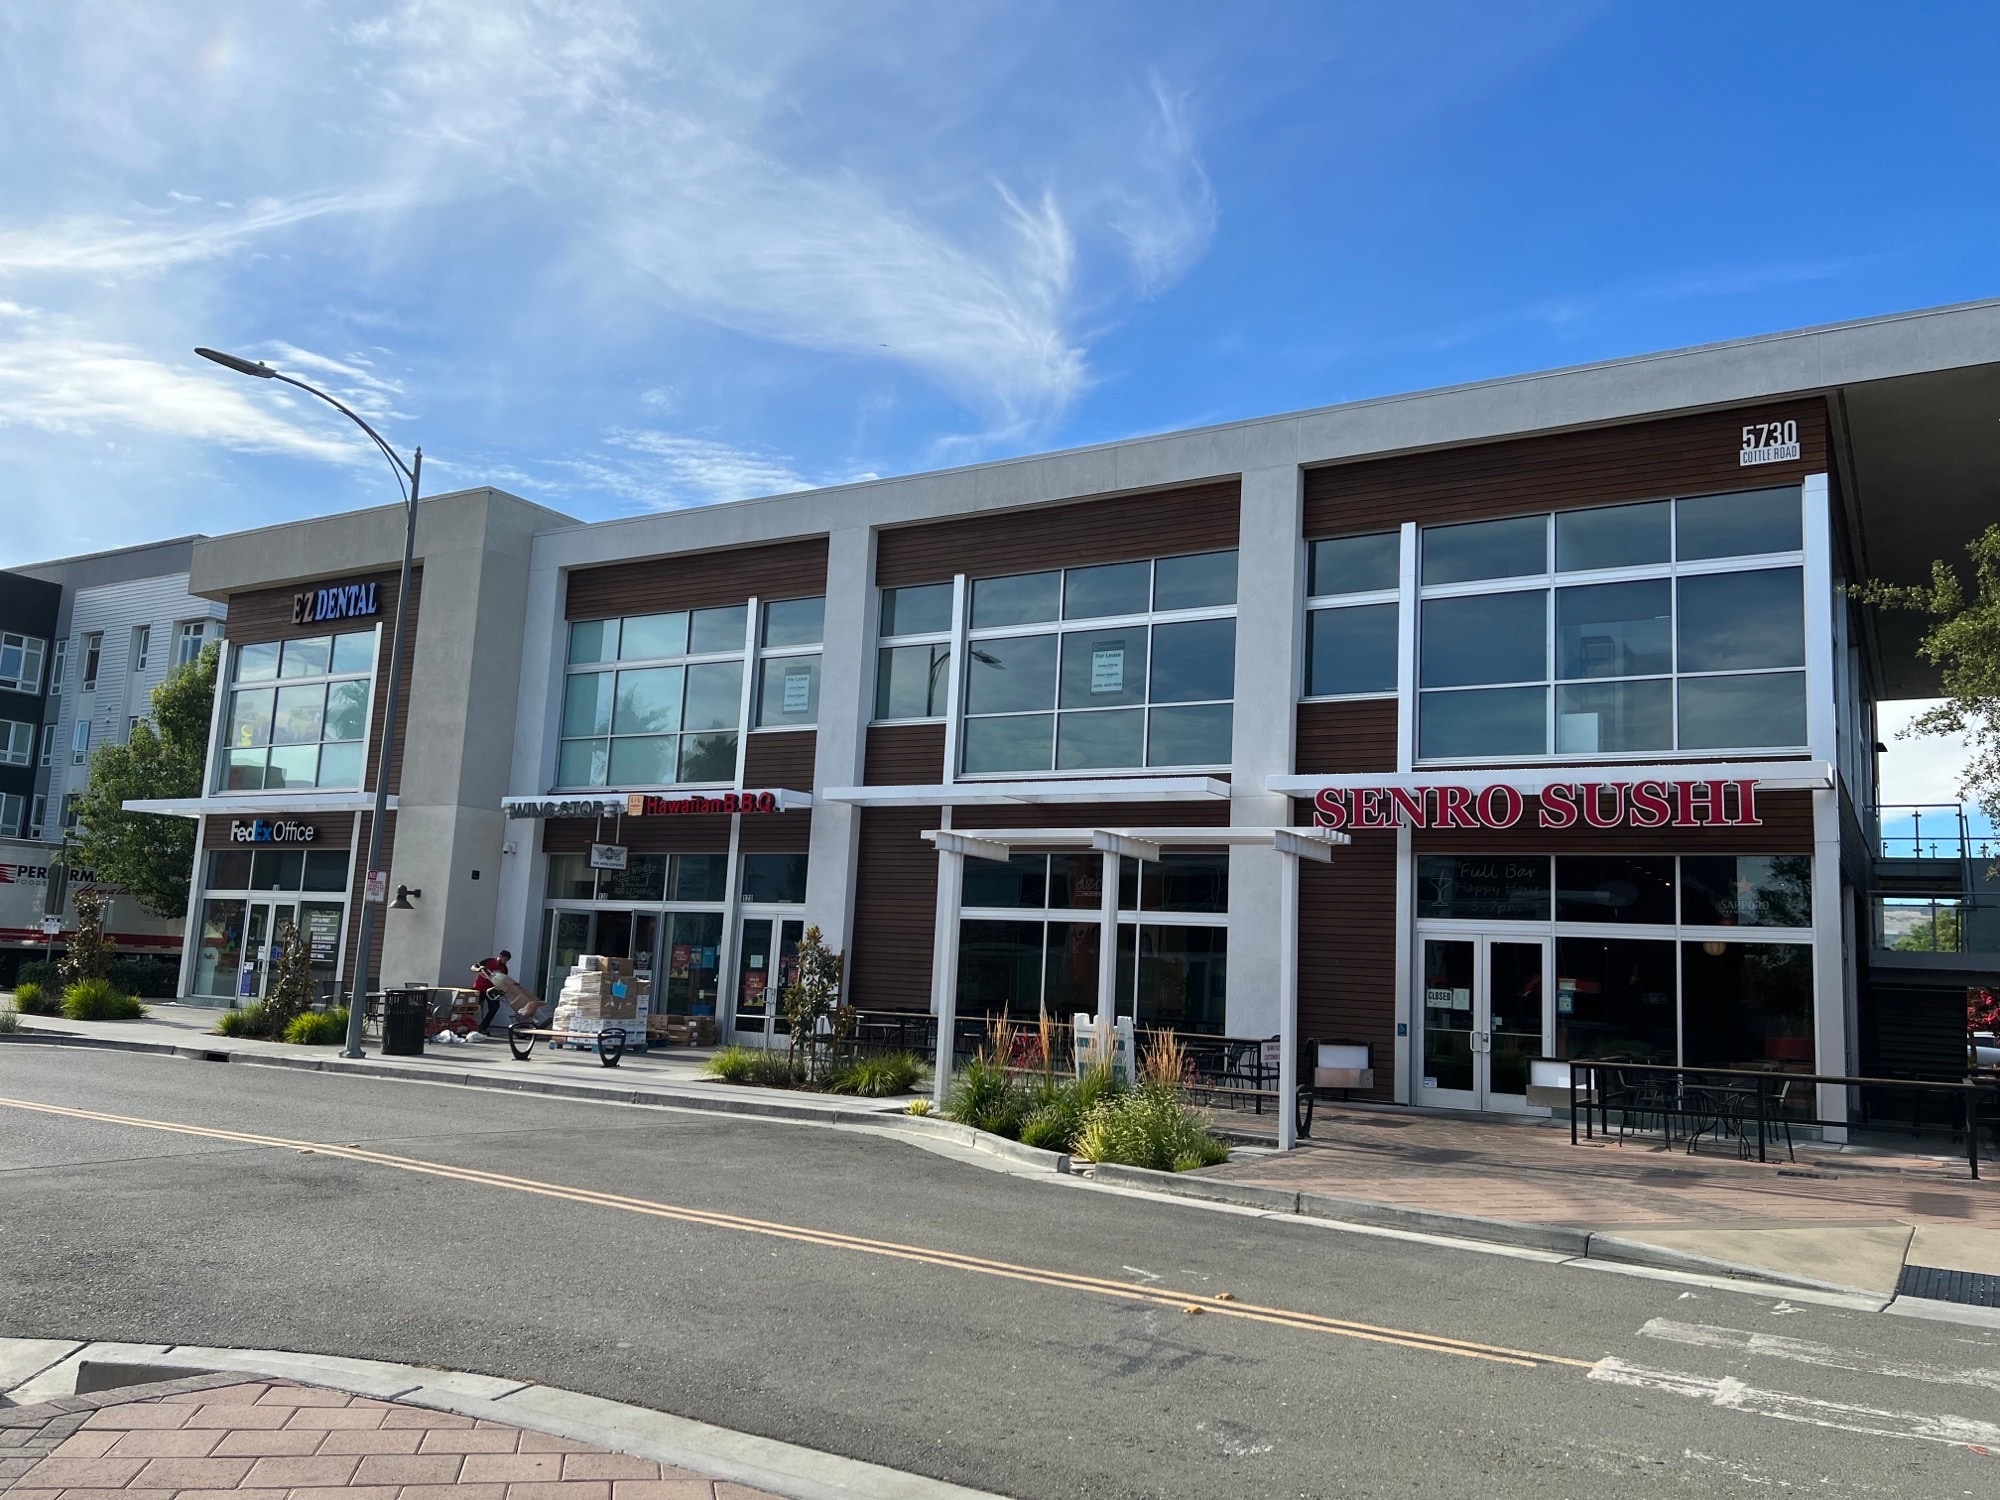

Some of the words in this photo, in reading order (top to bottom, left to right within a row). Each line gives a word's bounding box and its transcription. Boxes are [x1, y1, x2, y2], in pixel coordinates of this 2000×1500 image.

[1742, 420, 1797, 450] 5730
[1742, 449, 1771, 464] COTTLE
[1773, 445, 1797, 460] ROAD
[291, 591, 315, 624] EZ
[315, 581, 377, 621] DENTAL
[1313, 784, 1524, 829] SENRO
[1538, 779, 1763, 829] SUSHI
[230, 819, 273, 842] FedEx
[273, 820, 314, 841] Office
[1460, 862, 1499, 879] Full
[1505, 863, 1537, 879] Bar
[1720, 900, 1770, 911] SAPPORO
[1428, 990, 1451, 1001] CLOSED
